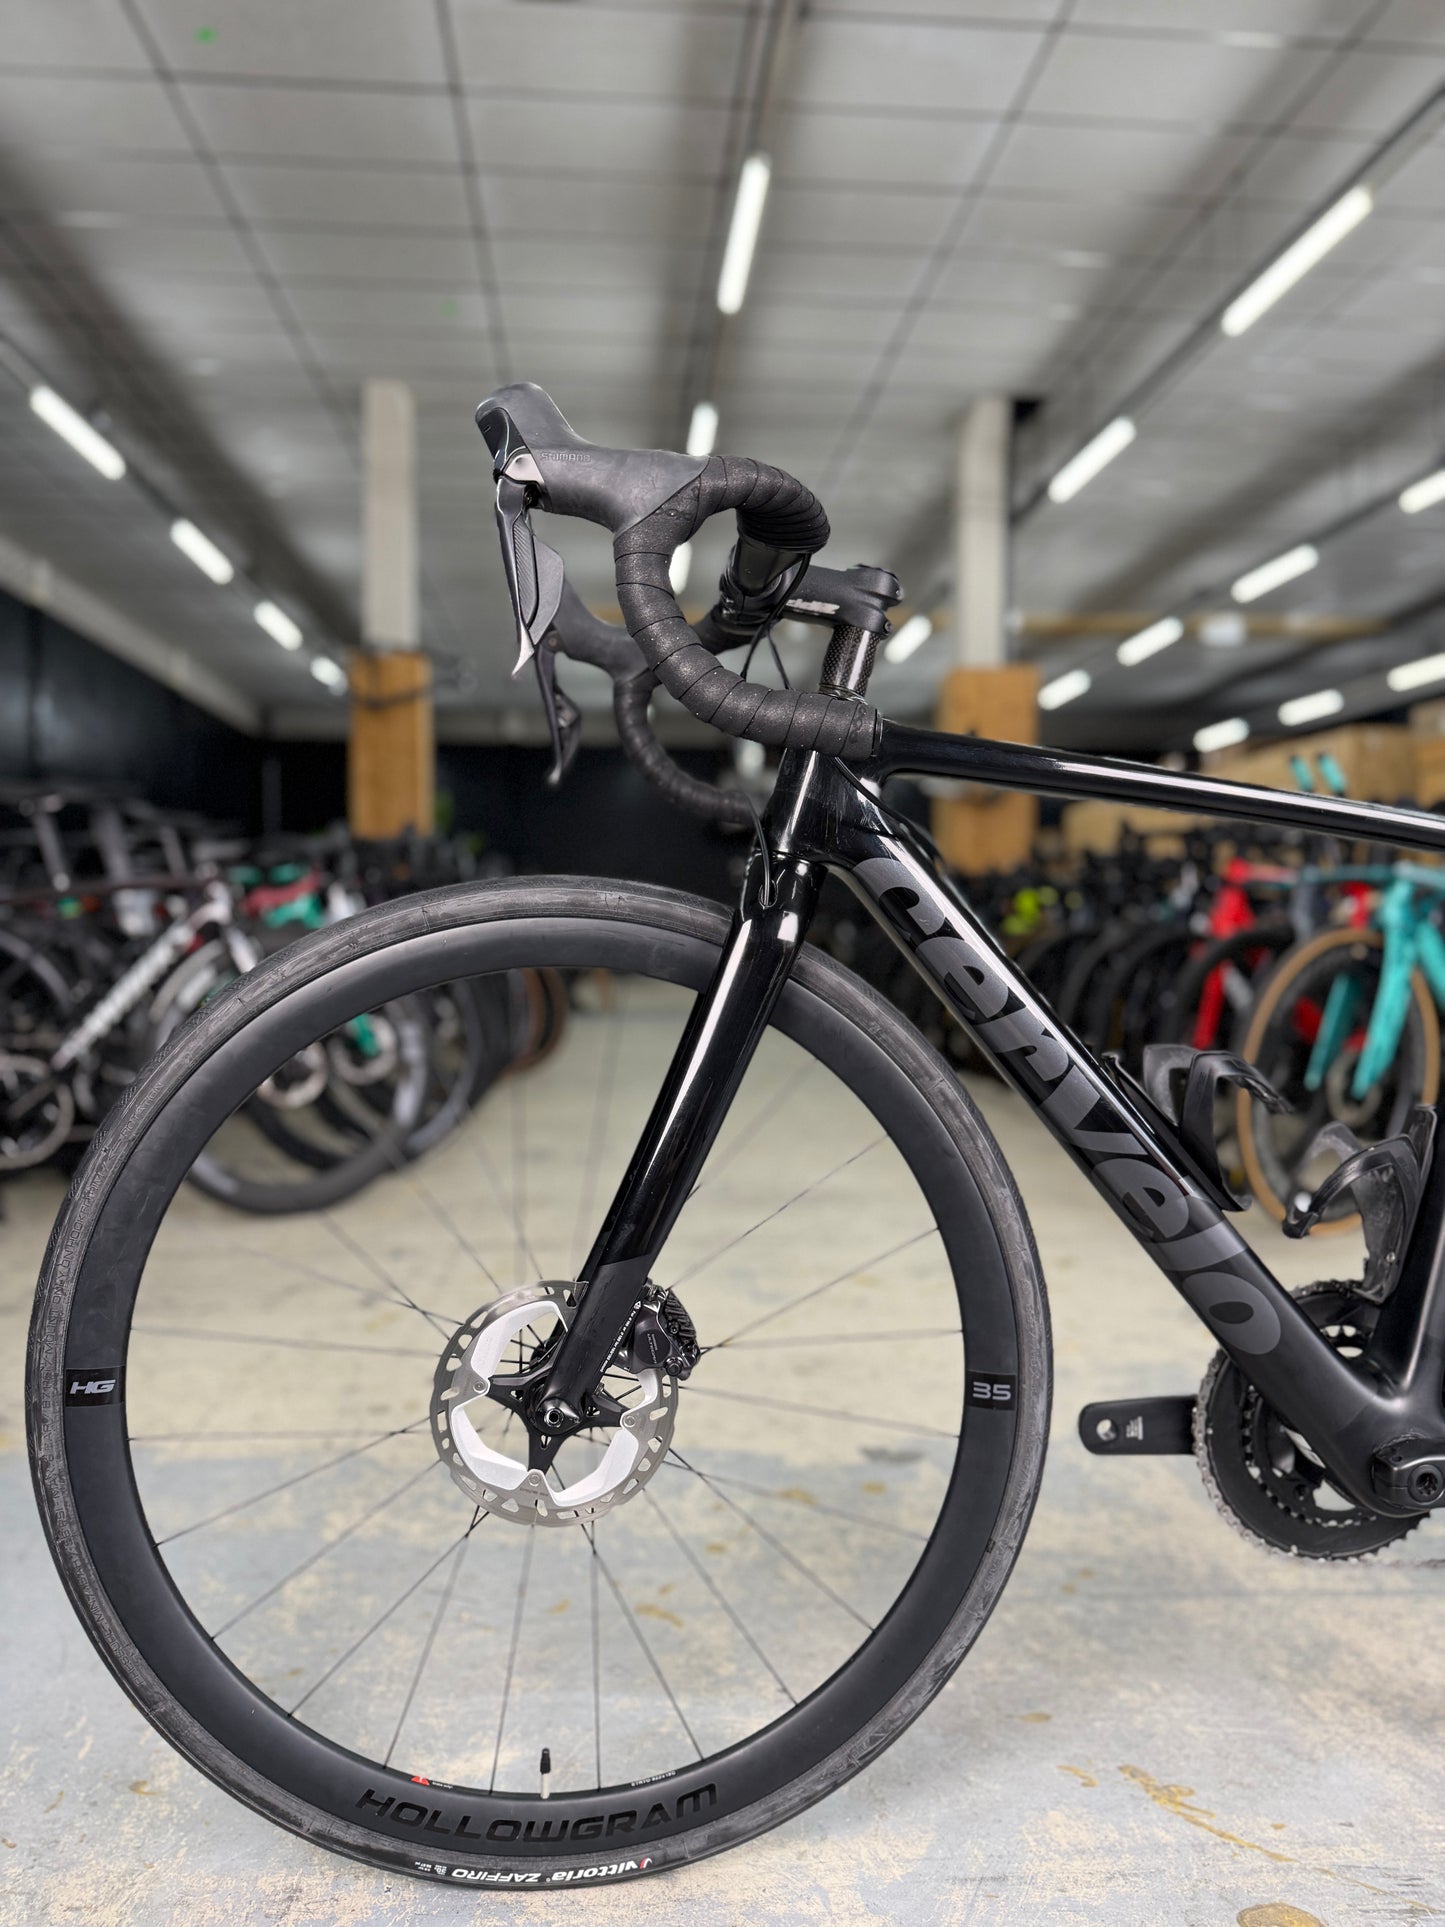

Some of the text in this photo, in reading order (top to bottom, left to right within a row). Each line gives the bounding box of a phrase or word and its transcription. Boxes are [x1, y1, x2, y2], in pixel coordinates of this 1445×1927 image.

[541, 451, 592, 462] SHIMANO
[70, 1379, 116, 1394] HG
[973, 1381, 1012, 1400] 35
[355, 1782, 719, 1843] HOLLOWGRAM
[451, 1868, 542, 1883] ZAFFIRO
[551, 1860, 639, 1882] vittoria
